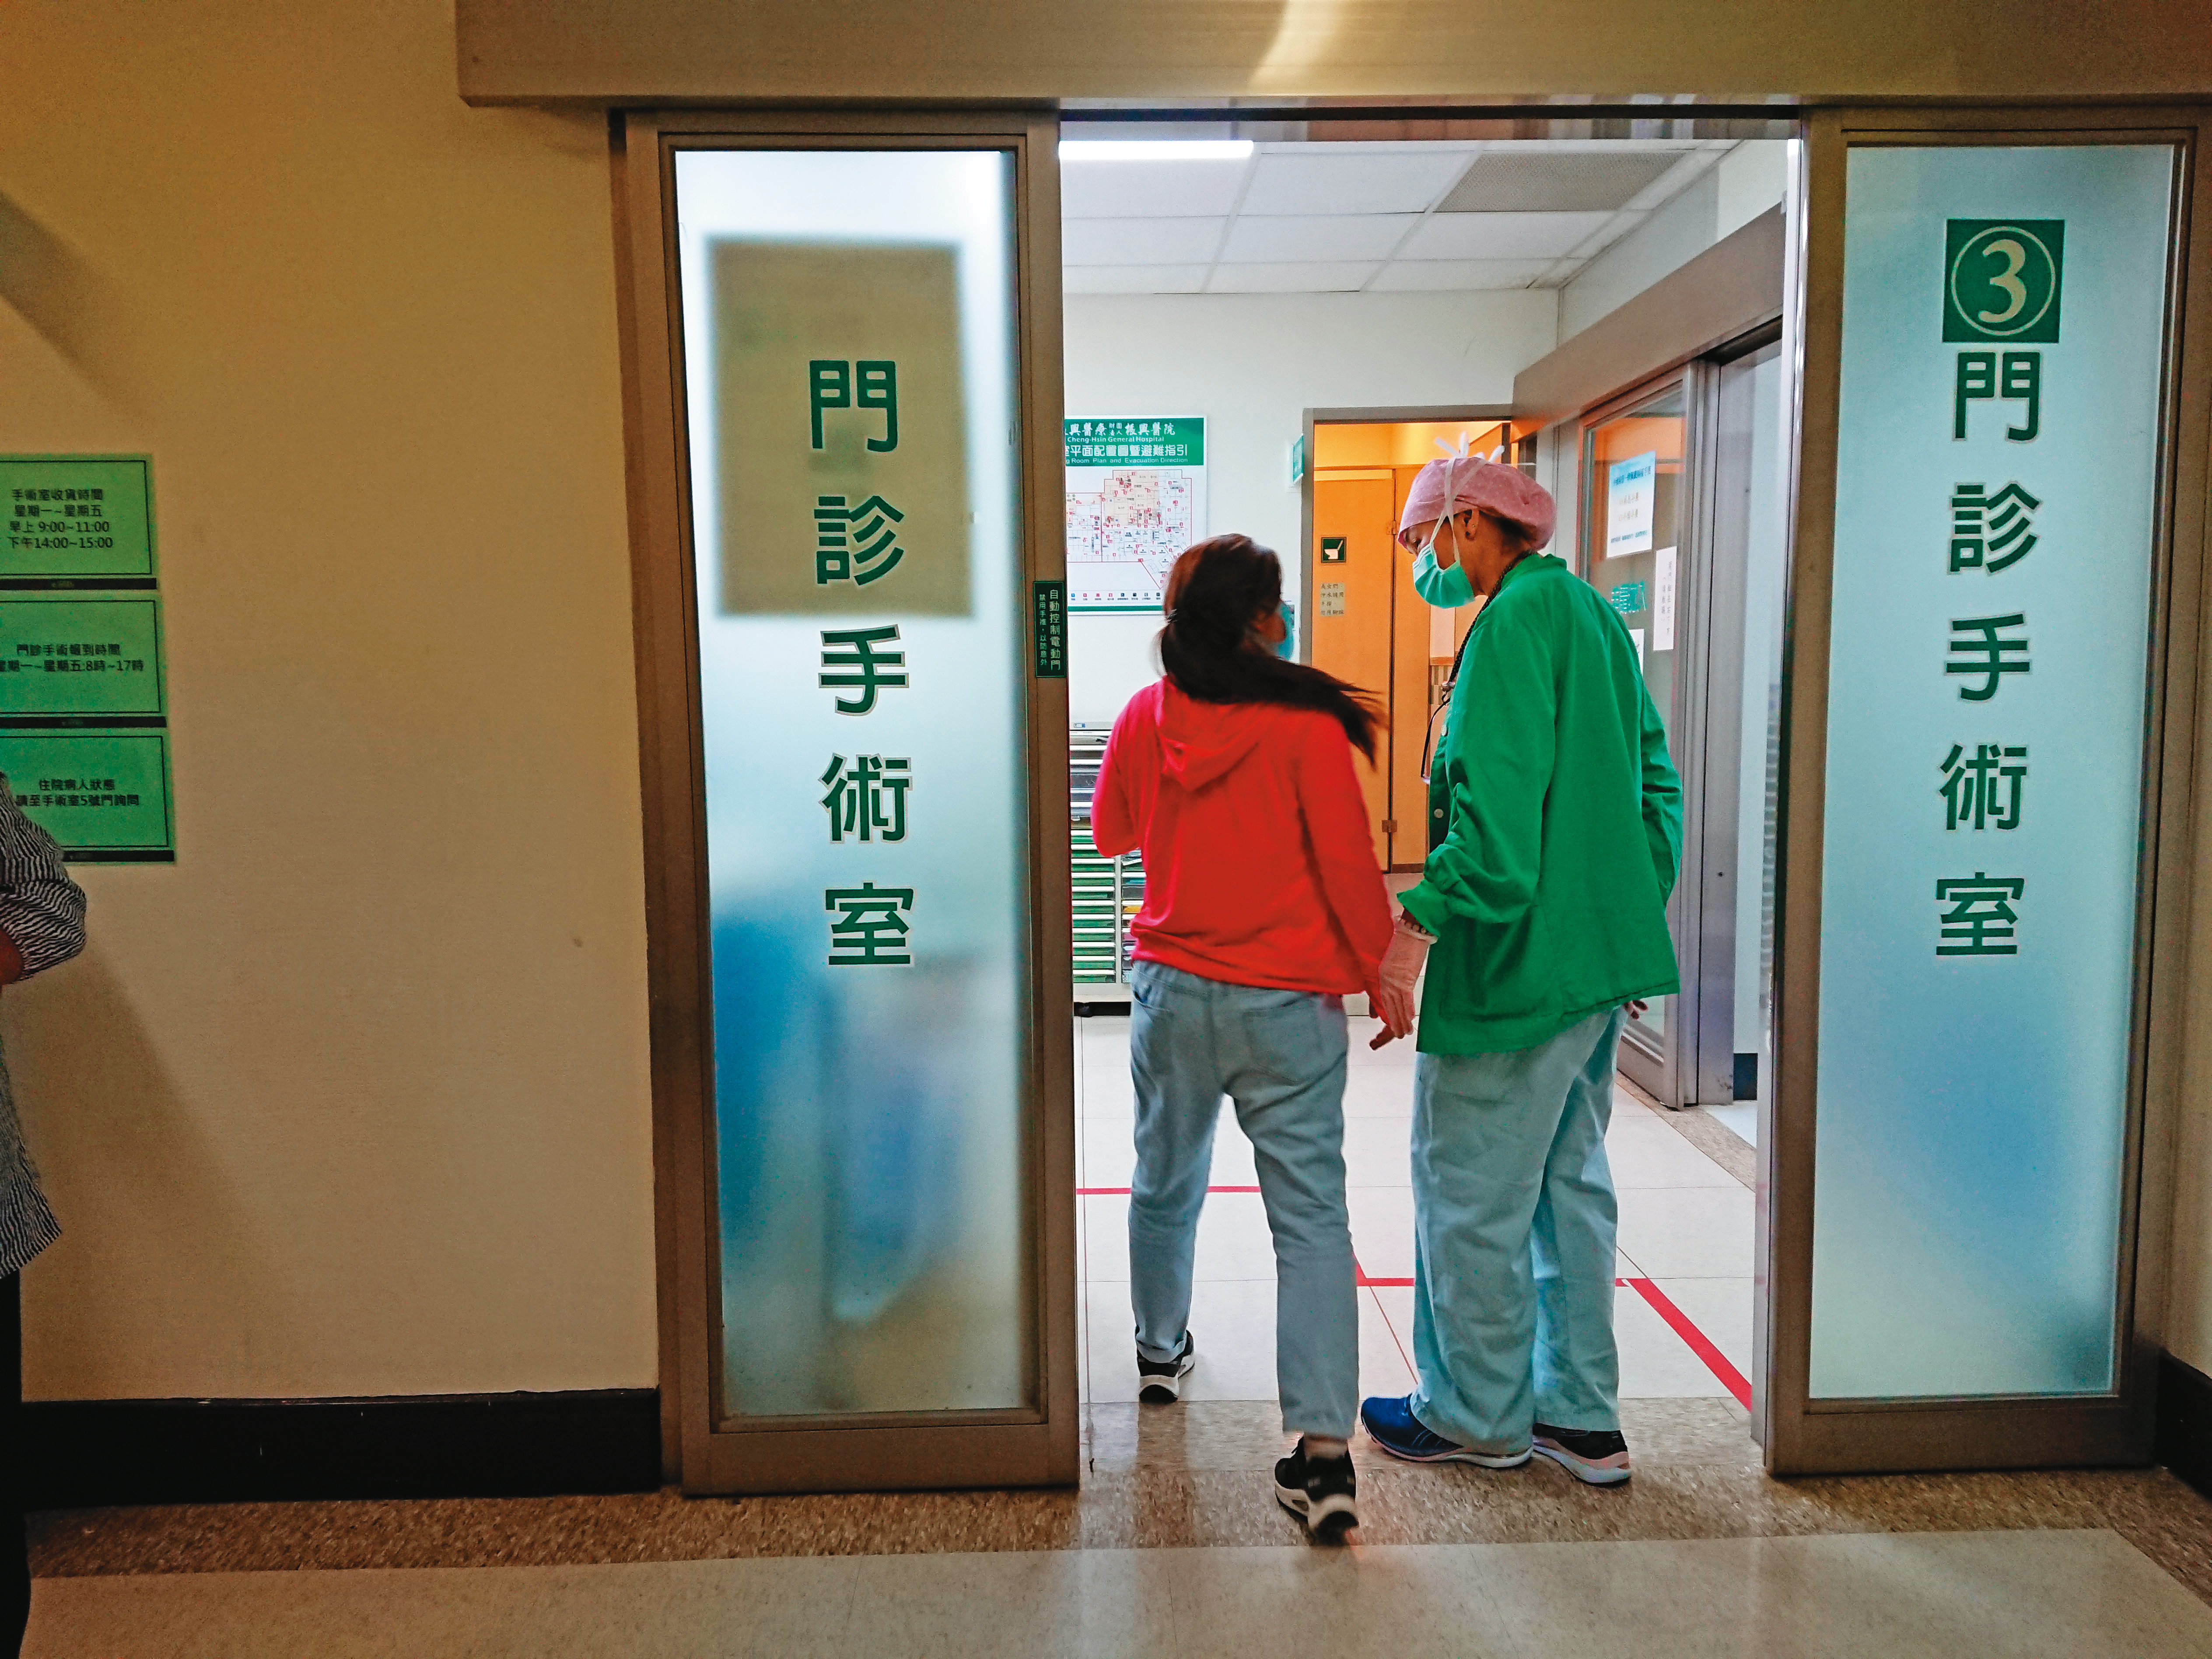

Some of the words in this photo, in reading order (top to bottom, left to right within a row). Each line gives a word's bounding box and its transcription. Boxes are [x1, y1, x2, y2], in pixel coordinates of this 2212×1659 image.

[1978, 239, 2026, 322] 3
[10, 521, 34, 533] 早上
[808, 359, 914, 966] 門診手術室
[1049, 589, 1061, 671] 自動控制電動門
[1936, 351, 2041, 956] 門診手術室
